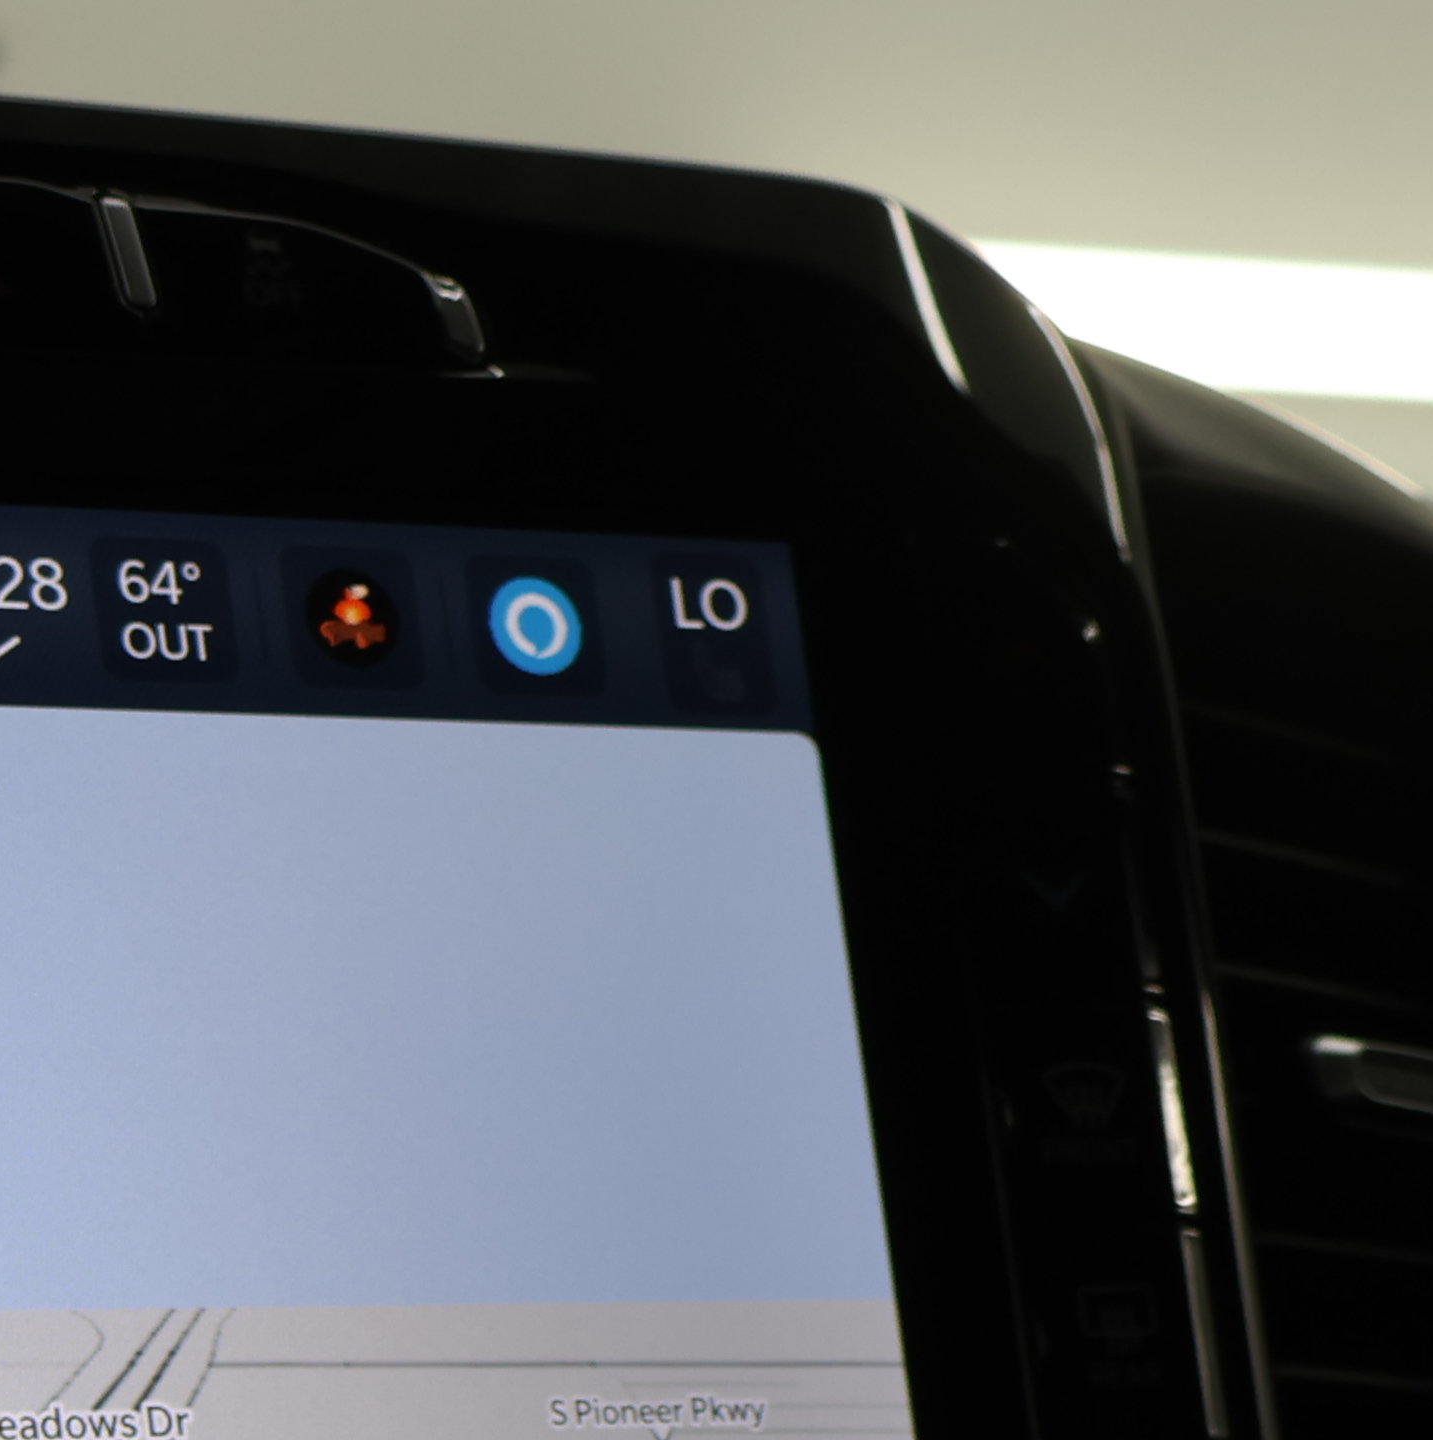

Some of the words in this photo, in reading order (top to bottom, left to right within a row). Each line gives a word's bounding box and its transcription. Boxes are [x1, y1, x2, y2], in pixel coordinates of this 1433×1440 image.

[118, 559, 201, 605] 64°
[670, 577, 747, 631] LO
[122, 621, 213, 662] OUT
[146, 1406, 188, 1437] Dr
[550, 1399, 568, 1426] S
[574, 1399, 682, 1425] Pioneer
[690, 1397, 762, 1427] Pkwy
